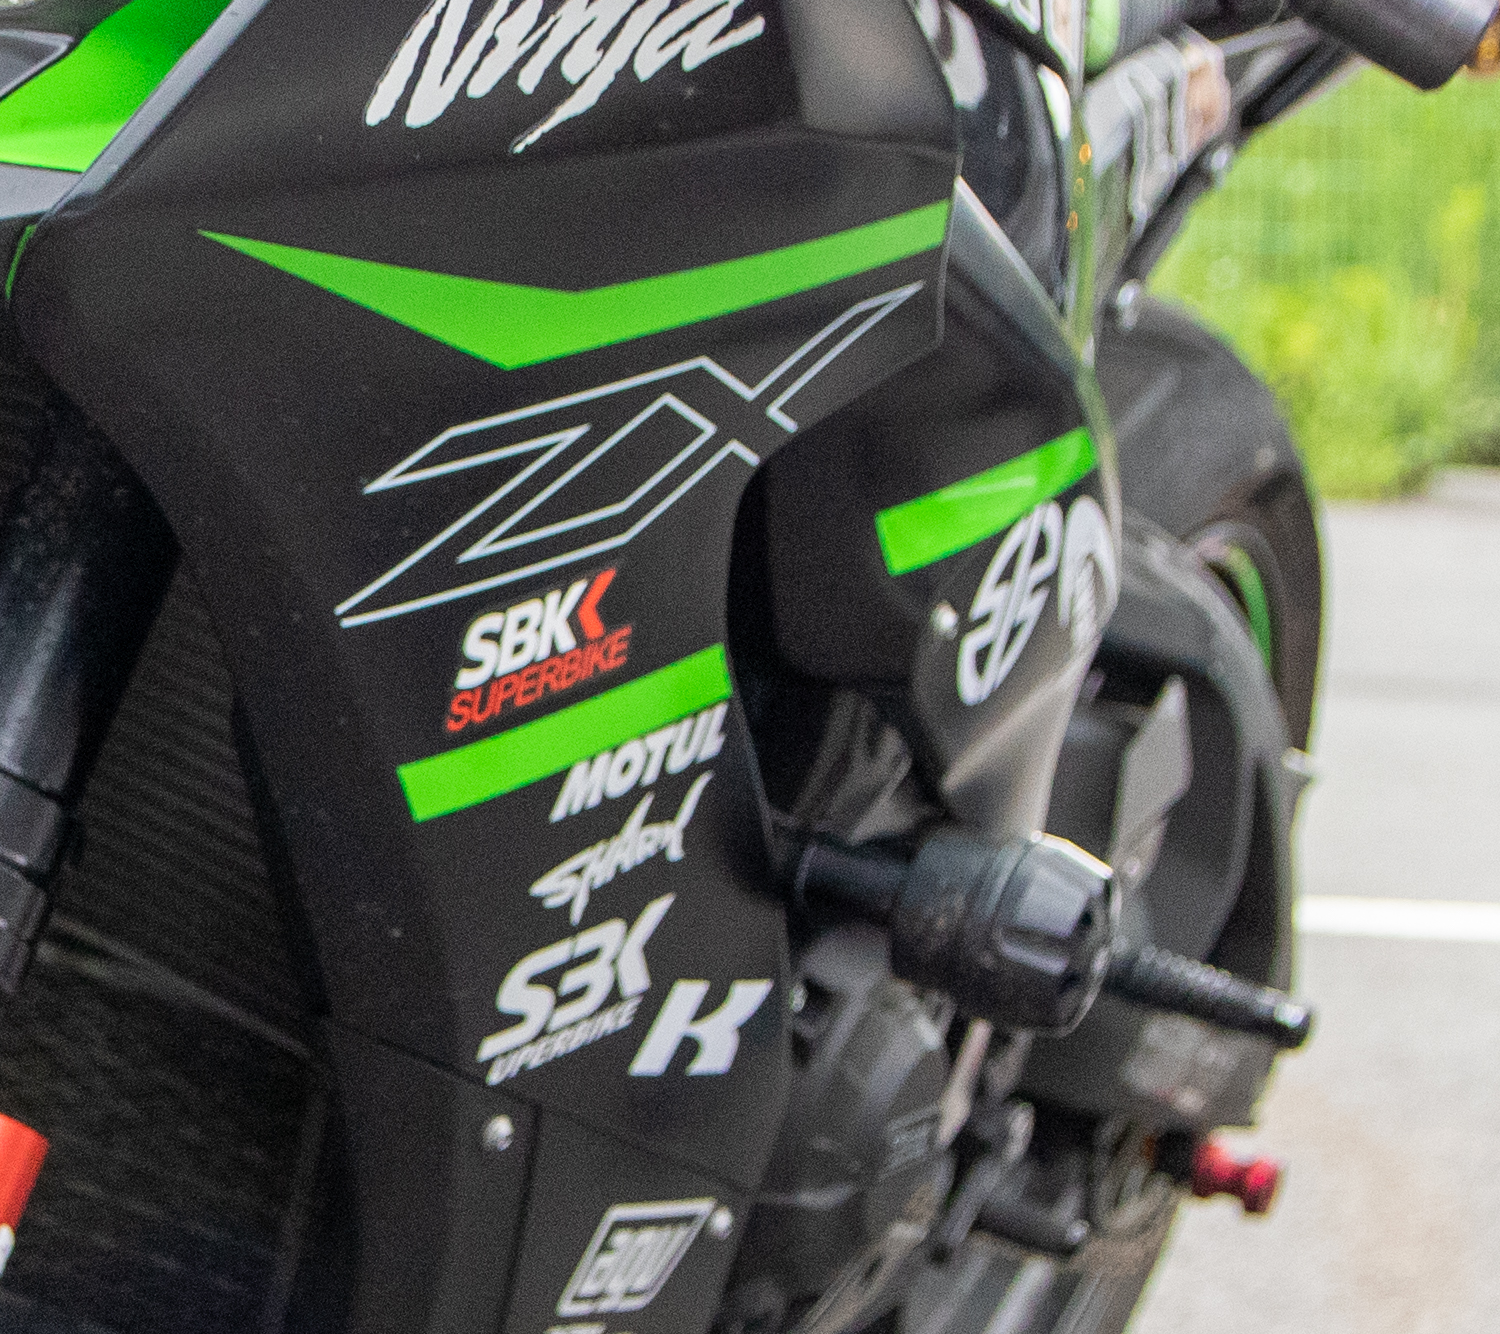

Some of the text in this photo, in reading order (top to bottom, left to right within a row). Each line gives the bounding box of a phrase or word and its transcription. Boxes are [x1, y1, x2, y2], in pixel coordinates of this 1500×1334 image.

[335, 281, 924, 628] ZX
[446, 623, 633, 733] SUPERBIKE
[454, 578, 590, 690] SBK
[549, 702, 729, 824] MOTUL
